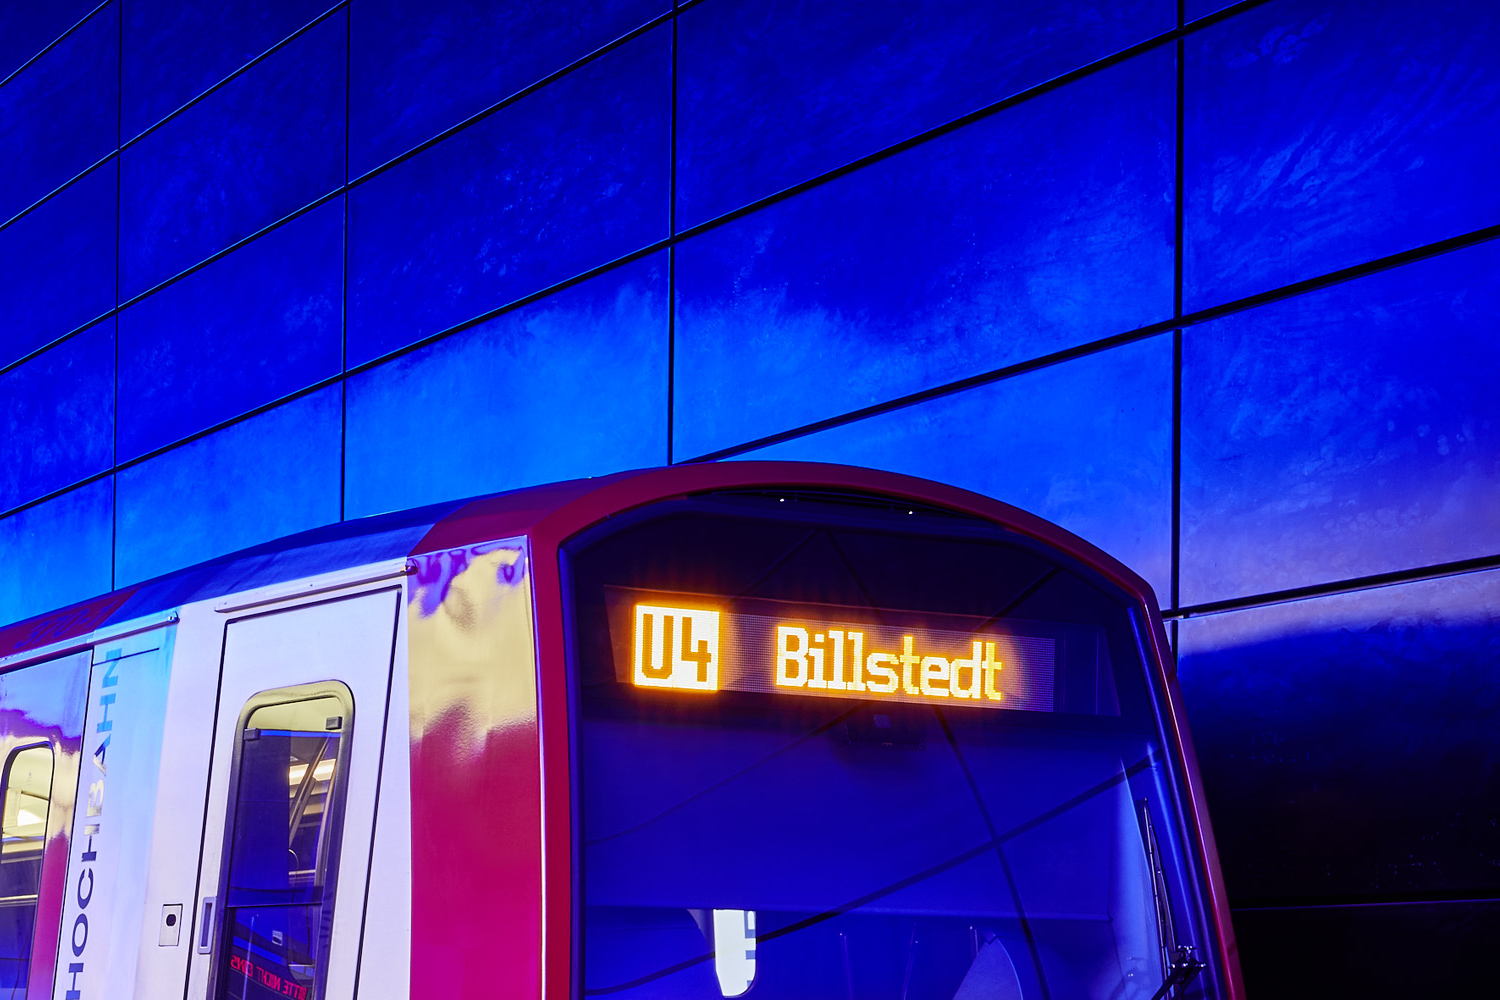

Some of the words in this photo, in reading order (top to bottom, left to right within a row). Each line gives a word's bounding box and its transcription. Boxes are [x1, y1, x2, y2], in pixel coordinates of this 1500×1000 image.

[641, 612, 712, 682] U4
[776, 625, 1003, 702] Billstedt
[65, 648, 122, 1000] HOCHBAHN
